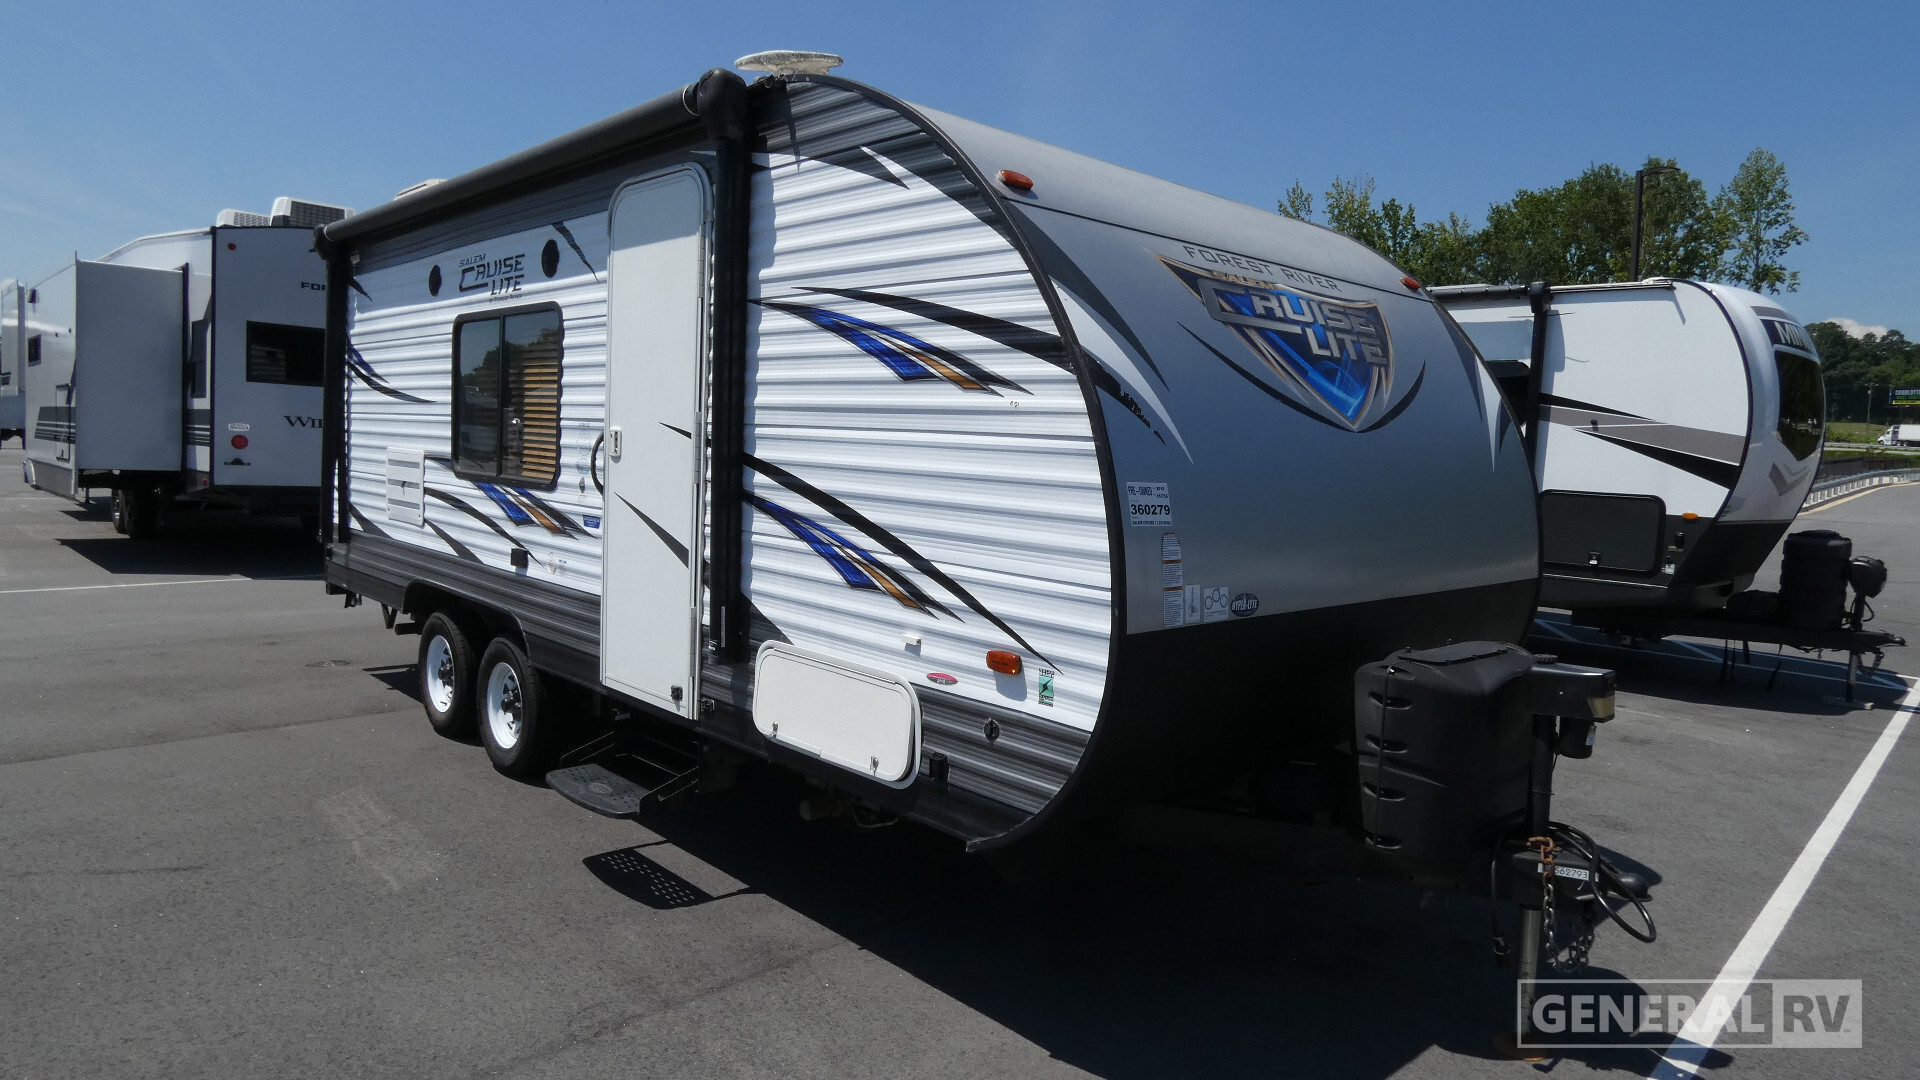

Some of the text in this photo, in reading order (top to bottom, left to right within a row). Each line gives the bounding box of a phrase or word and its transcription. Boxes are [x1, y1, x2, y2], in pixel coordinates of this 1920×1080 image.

[459, 253, 486, 267] SALEM
[459, 253, 526, 293] CRUISE
[1182, 245, 1343, 292] FOREST RIVER
[490, 274, 525, 296] LITE
[1197, 278, 1378, 338] CRUISE
[1305, 326, 1388, 367] LITE
[1130, 503, 1171, 516] 360279
